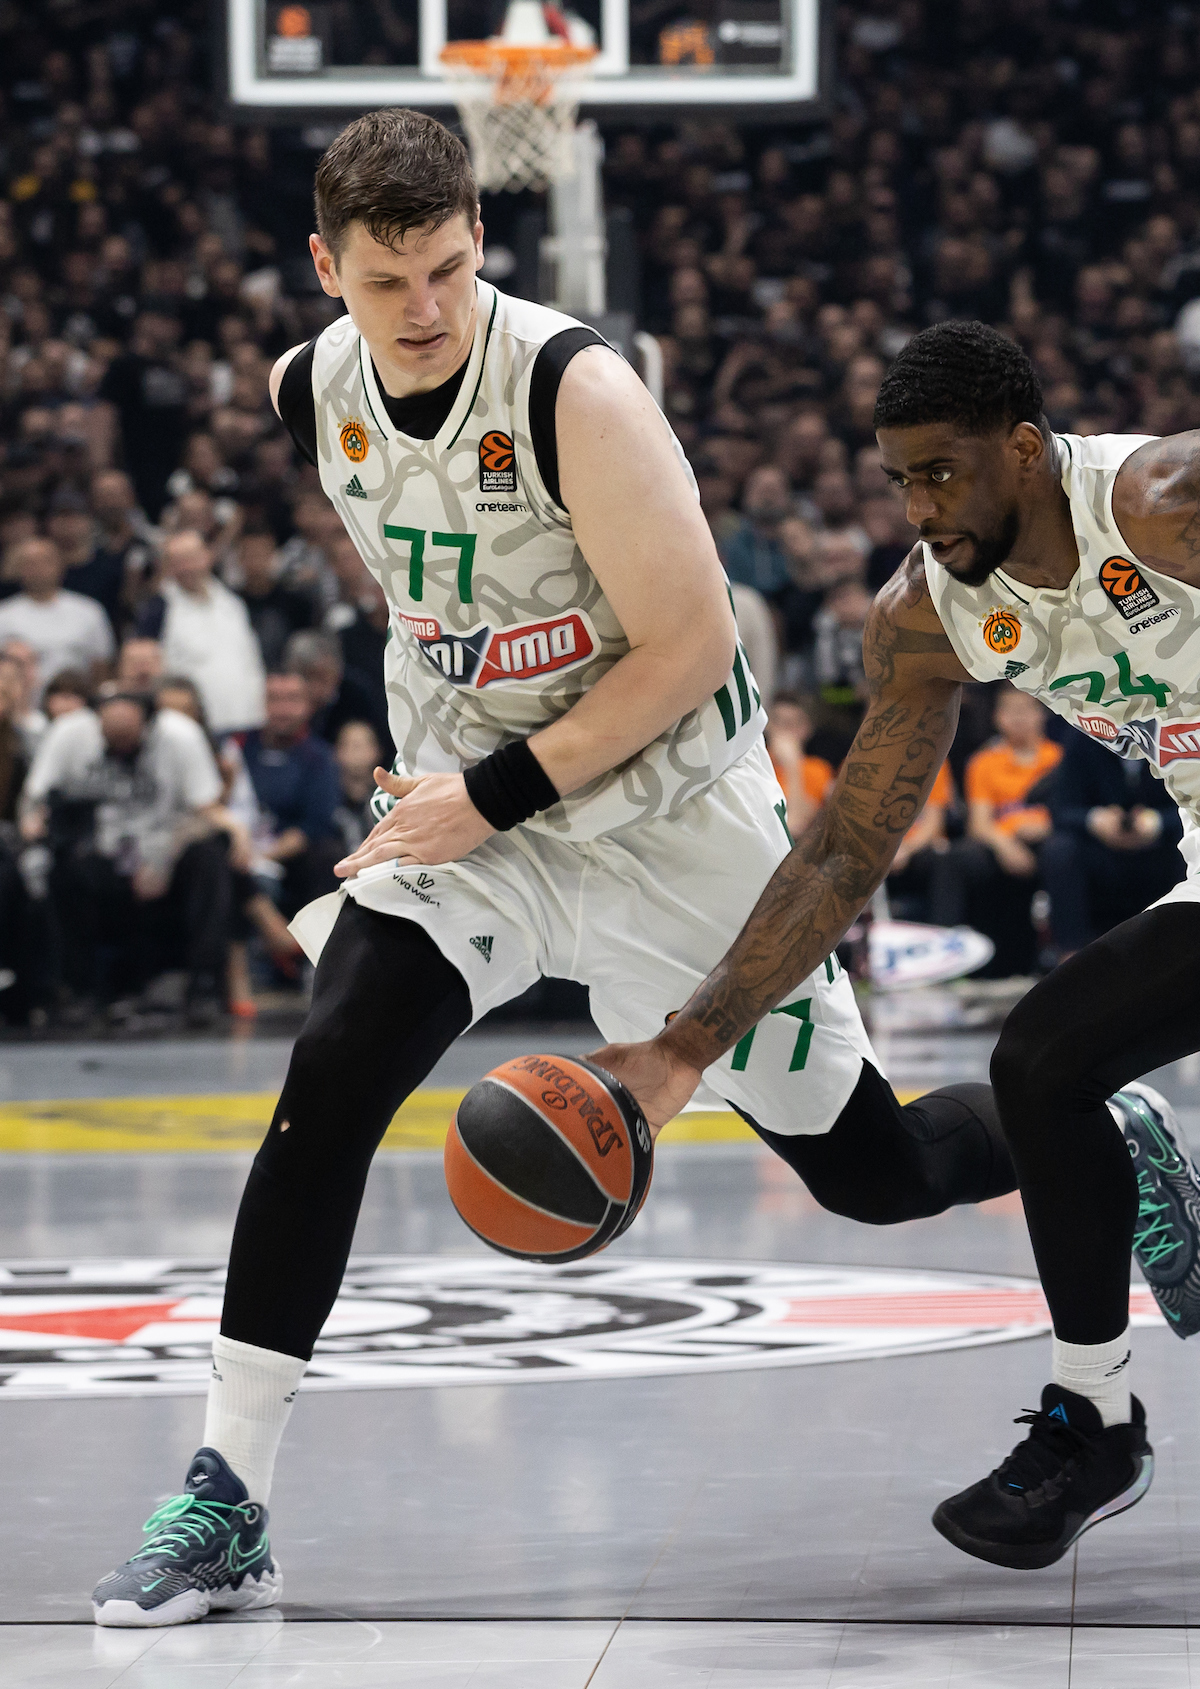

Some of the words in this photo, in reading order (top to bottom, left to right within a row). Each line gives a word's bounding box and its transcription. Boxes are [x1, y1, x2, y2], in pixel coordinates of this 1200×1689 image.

[475, 501, 527, 512] oneteam
[383, 523, 477, 603] 77
[1118, 587, 1149, 607] TURKISH
[1122, 593, 1153, 612] AIRLINES
[1129, 608, 1179, 635] oneteam
[1049, 650, 1172, 708] 24
[510, 1056, 624, 1158] SPALDING
